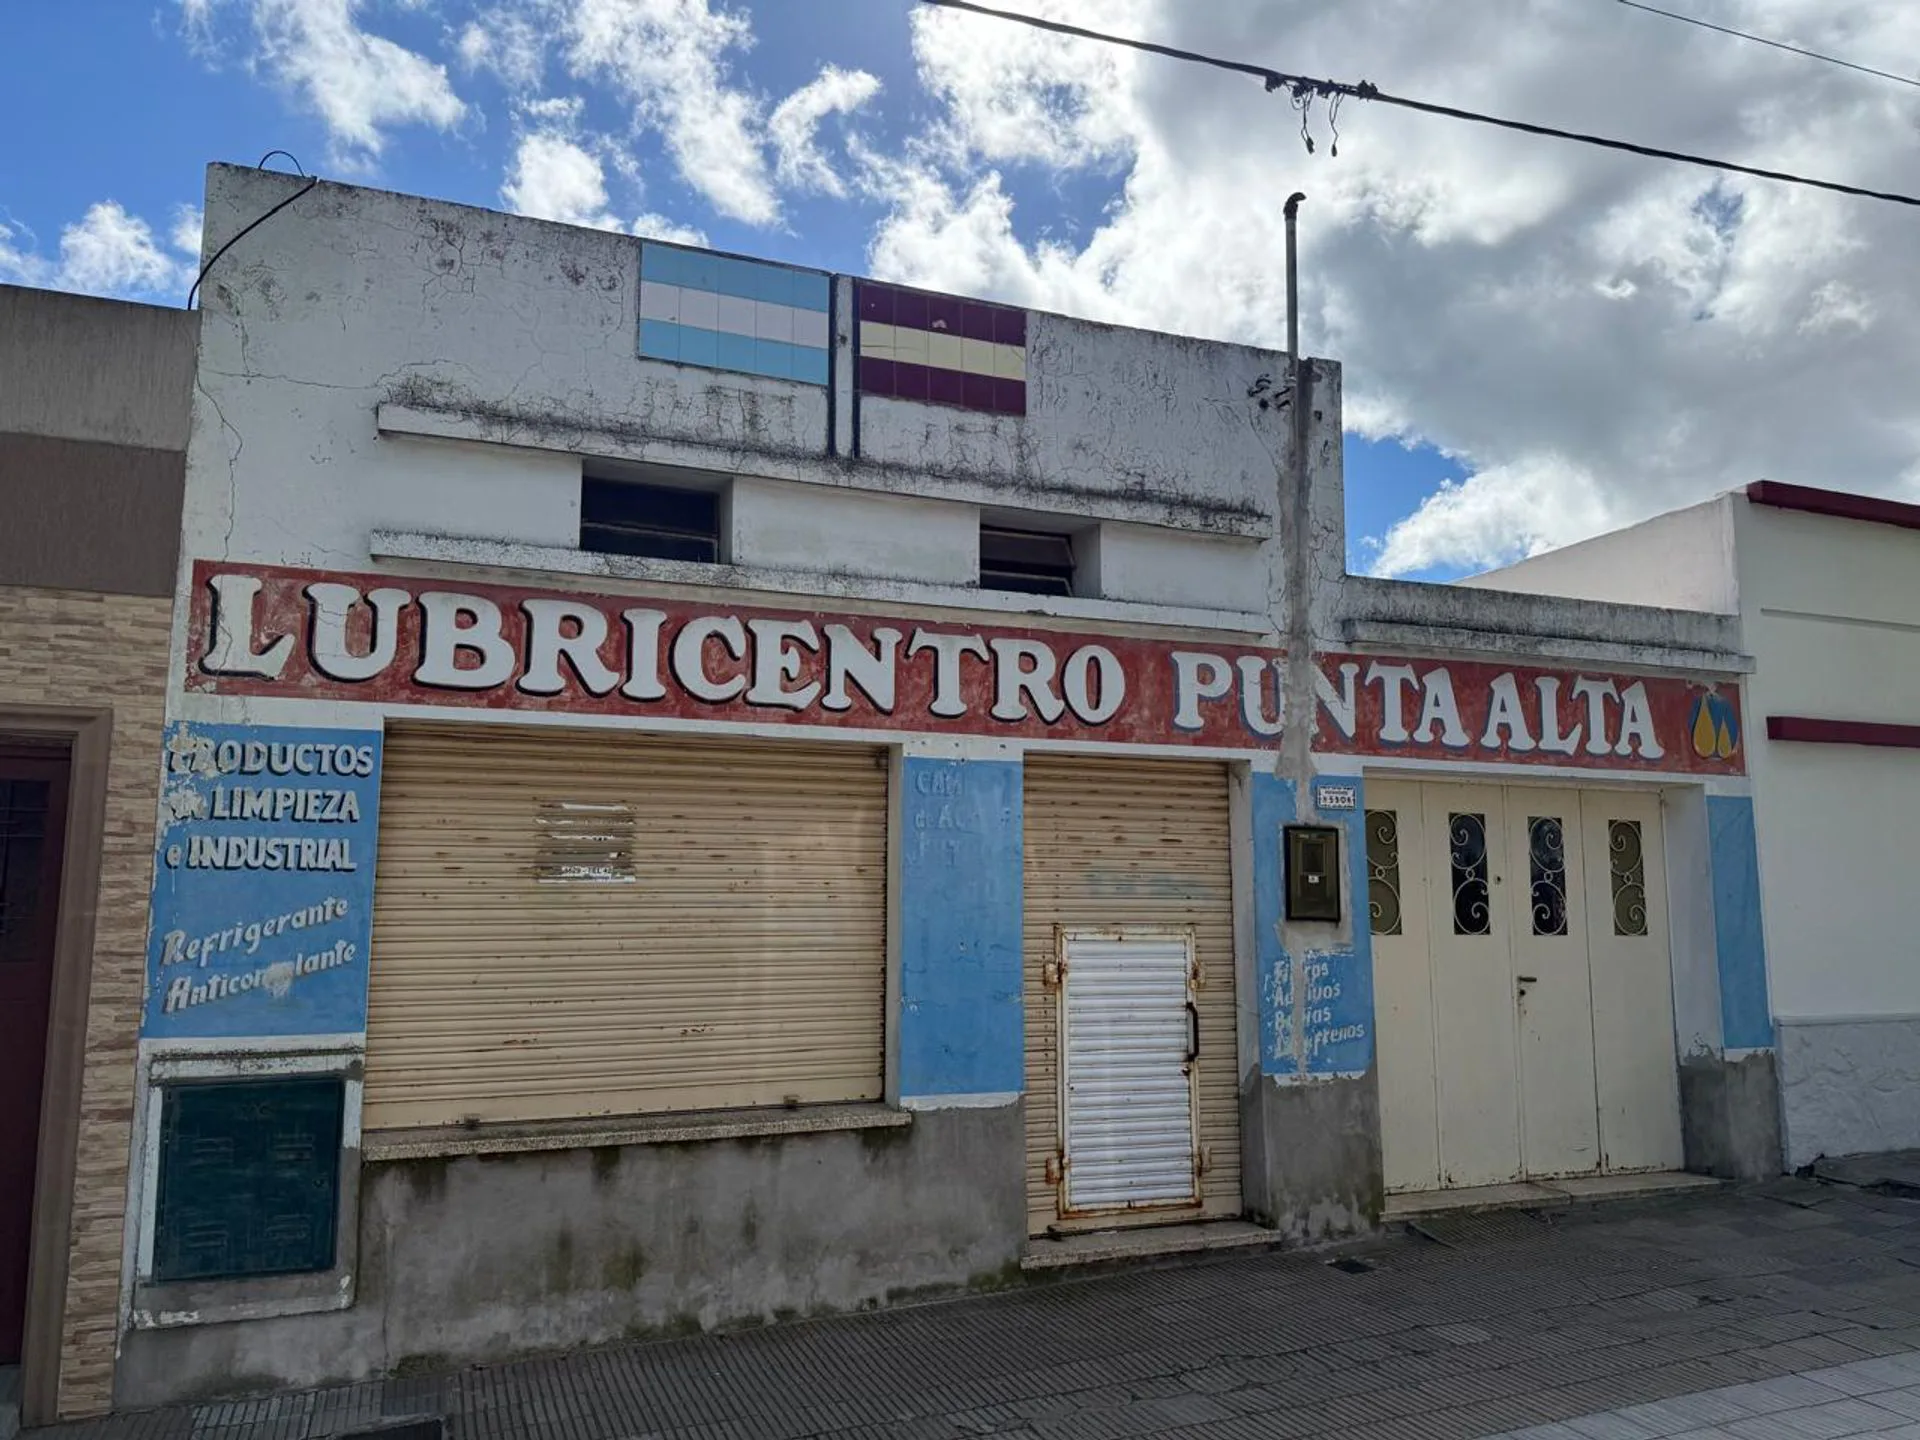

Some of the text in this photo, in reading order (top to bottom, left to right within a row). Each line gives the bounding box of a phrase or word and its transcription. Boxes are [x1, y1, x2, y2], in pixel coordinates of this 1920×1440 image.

[199, 574, 1666, 759] LUBRICENTRO PUNTA ALTA
[210, 786, 361, 823] LIMPIEZA
[187, 836, 358, 872] INDUSTRIAL
[161, 896, 349, 967] Refrigerante
